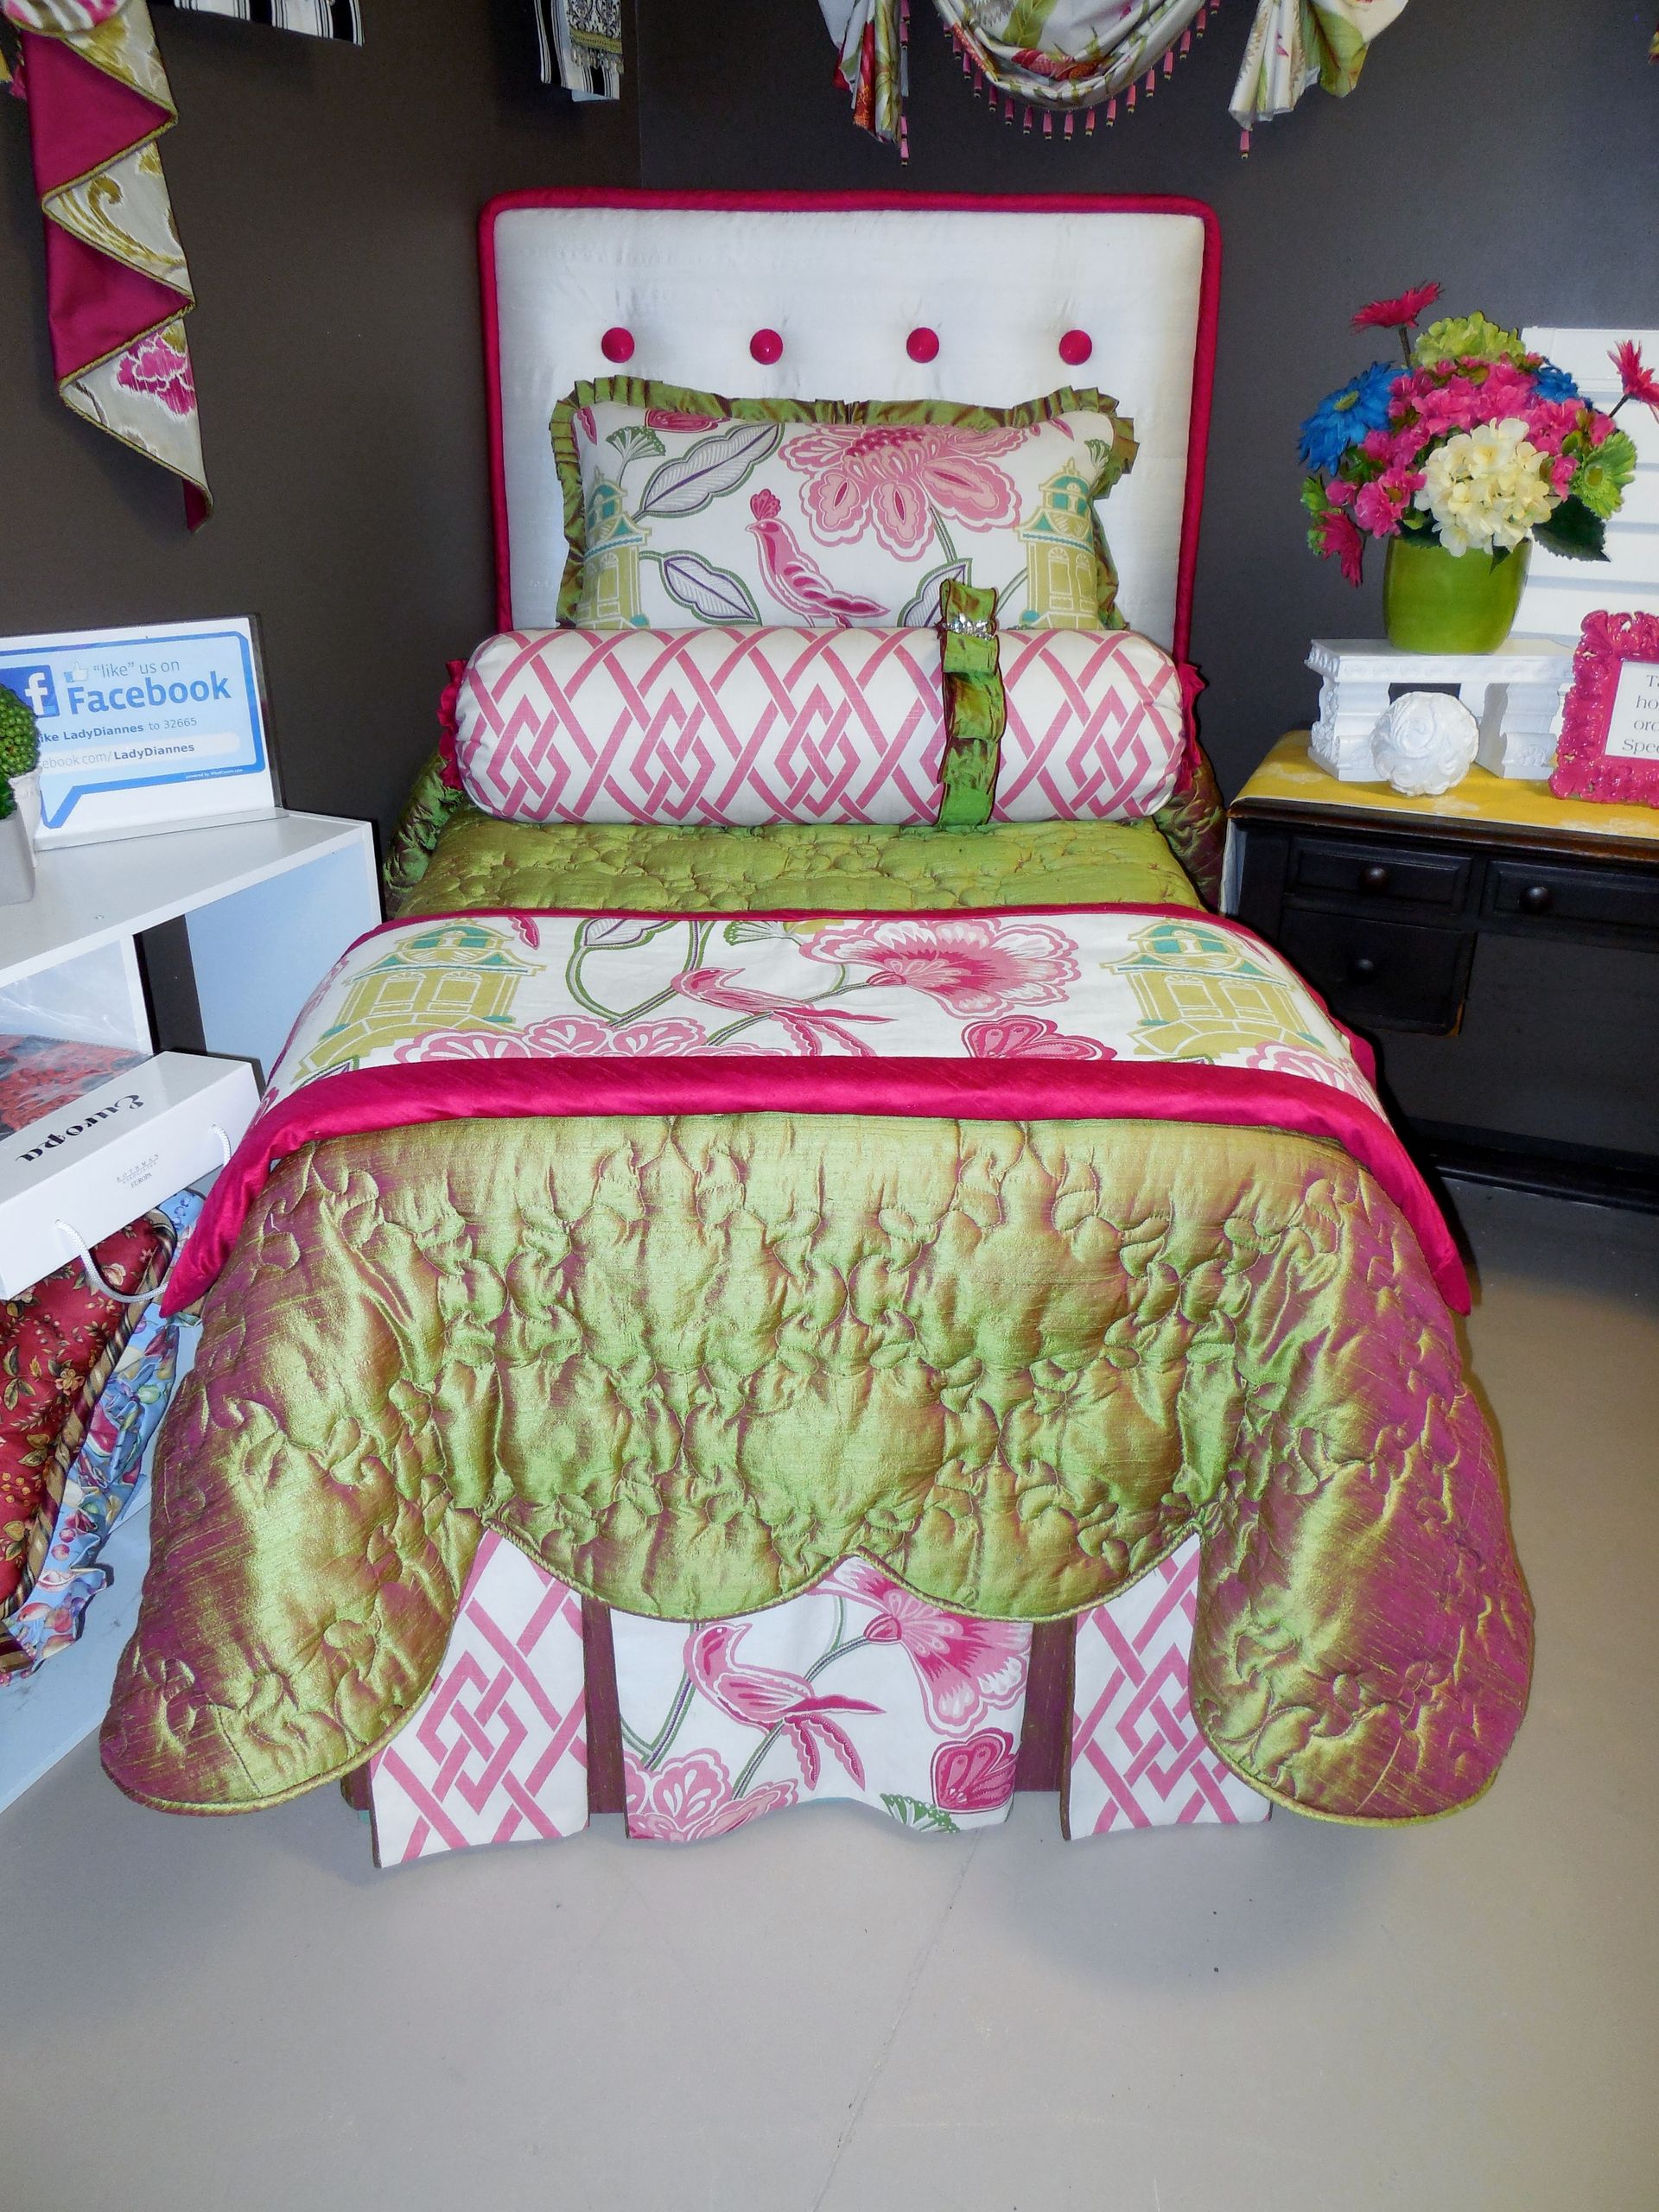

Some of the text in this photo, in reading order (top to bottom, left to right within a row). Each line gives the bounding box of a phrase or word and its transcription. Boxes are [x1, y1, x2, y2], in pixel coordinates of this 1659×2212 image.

[139, 663, 157, 675] us
[161, 661, 180, 672] on
[67, 671, 232, 715] Facebook
[64, 724, 143, 740] LadyDiannes
[149, 721, 160, 731] to
[163, 716, 197, 729] 32665
[16, 1095, 143, 1161] Europa
